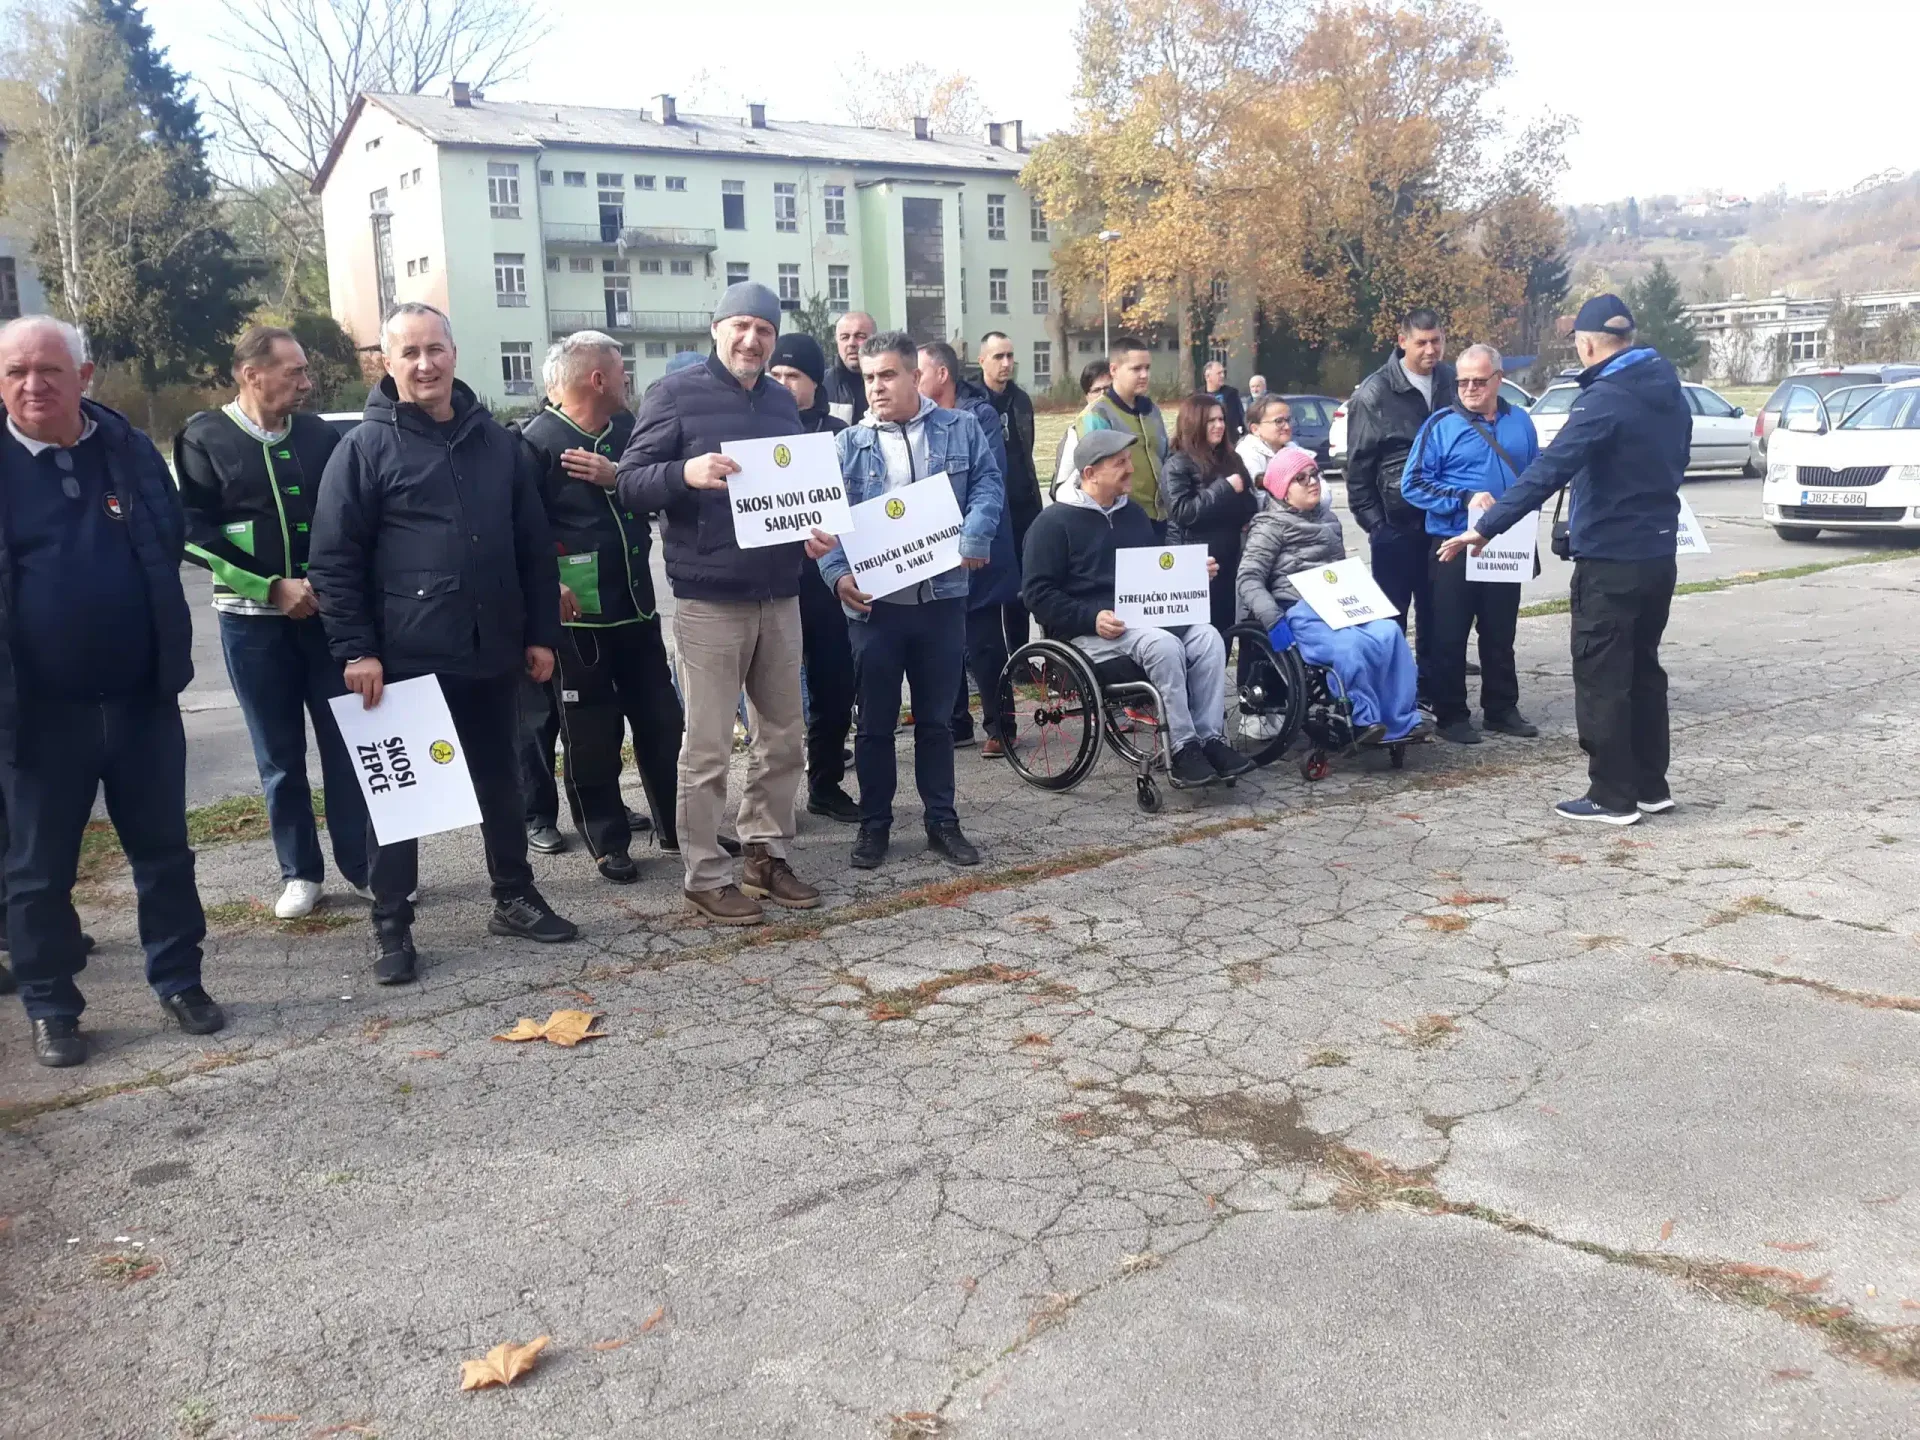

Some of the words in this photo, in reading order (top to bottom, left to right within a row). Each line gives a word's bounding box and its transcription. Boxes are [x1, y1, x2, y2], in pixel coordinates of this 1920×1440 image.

[736, 495, 773, 514] SKOSI
[776, 491, 805, 509] NOVI
[808, 486, 842, 504] GRAD
[1808, 493, 1863, 504] J82-E-686
[764, 510, 823, 532] SARAJEVO
[854, 548, 901, 574] STRELJAČKI
[902, 538, 925, 555] KLUB
[895, 563, 907, 574] D.
[907, 550, 935, 569] VAKUF
[1476, 562, 1488, 570] KLUB
[1118, 591, 1168, 605] STRELJAČKO
[1170, 589, 1208, 601] INVALIDSKI
[1143, 605, 1164, 615] KLUB
[1167, 604, 1189, 614] TUZLA
[356, 742, 394, 795] ŽEPČE
[383, 736, 417, 789] SKOSI
